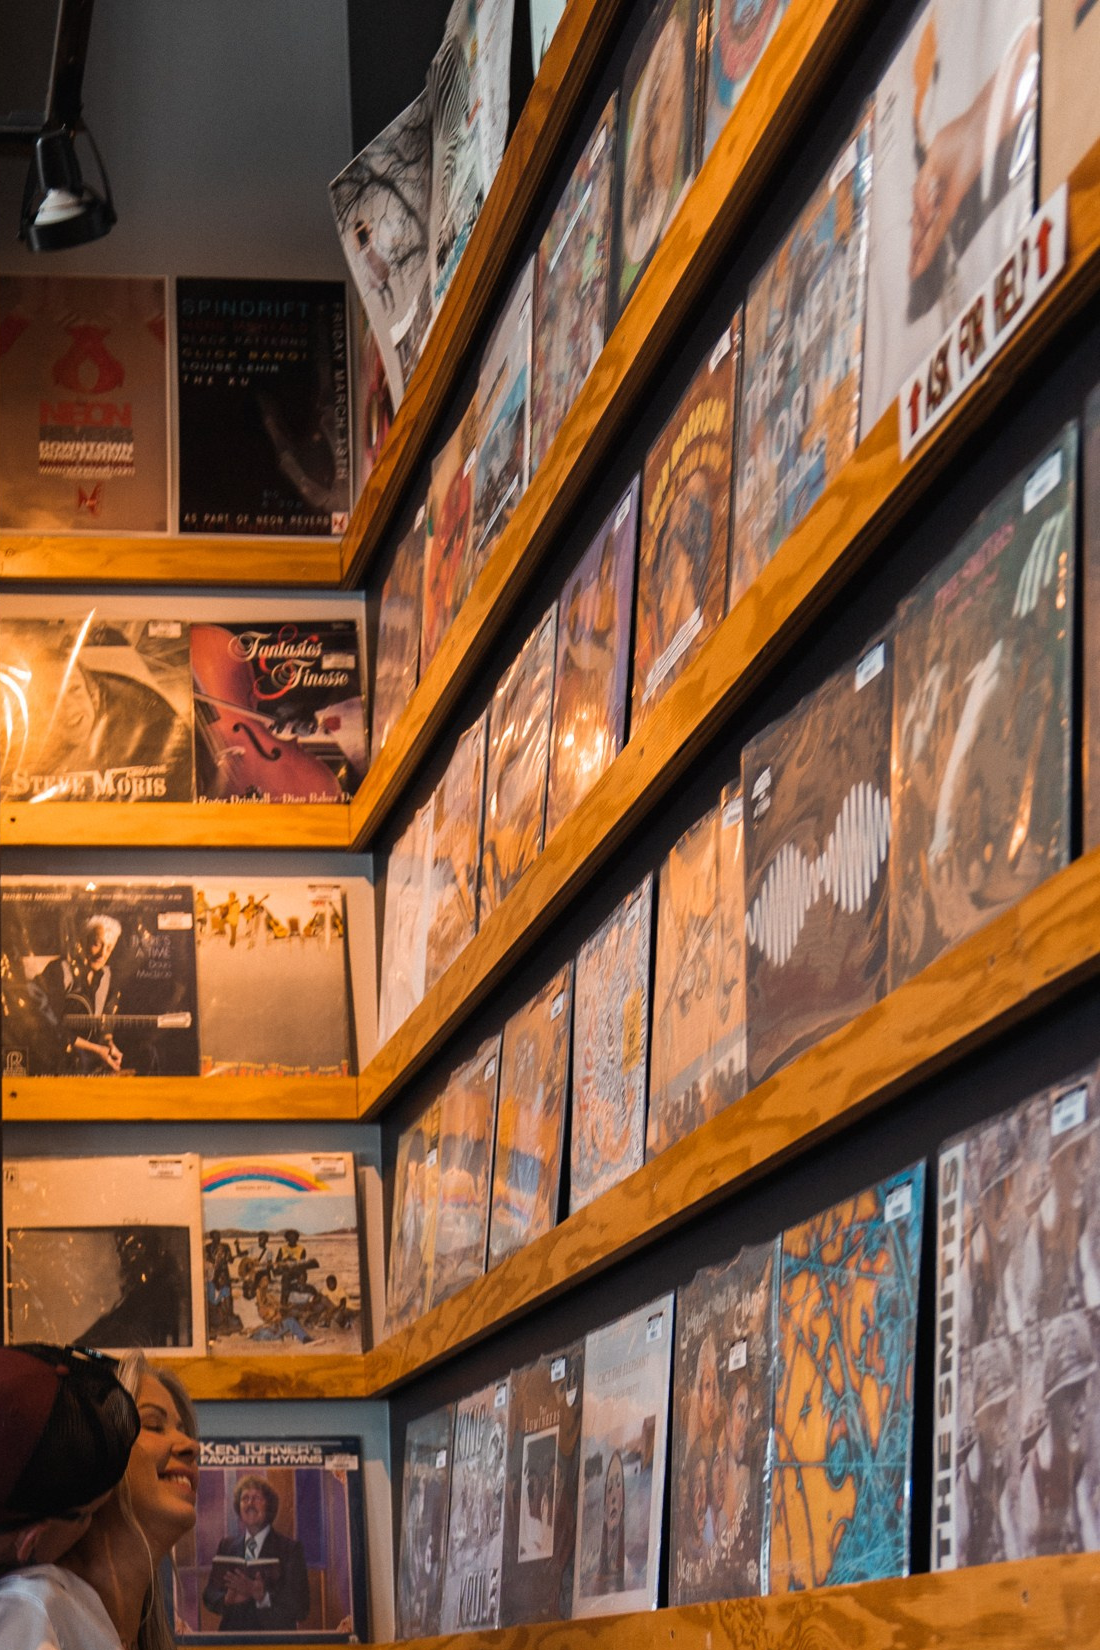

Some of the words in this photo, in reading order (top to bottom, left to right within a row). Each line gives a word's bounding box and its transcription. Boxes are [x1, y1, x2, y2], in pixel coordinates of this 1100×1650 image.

[182, 299, 310, 318] SPINDRIFT
[270, 660, 350, 695] Finesse
[11, 771, 87, 797] STEVE
[938, 1156, 964, 1411] SMITHS
[200, 1441, 240, 1456] KEN
[200, 1455, 266, 1465] FAVORITE
[269, 1455, 323, 1465] HYMNS
[935, 1434, 957, 1570] THE
